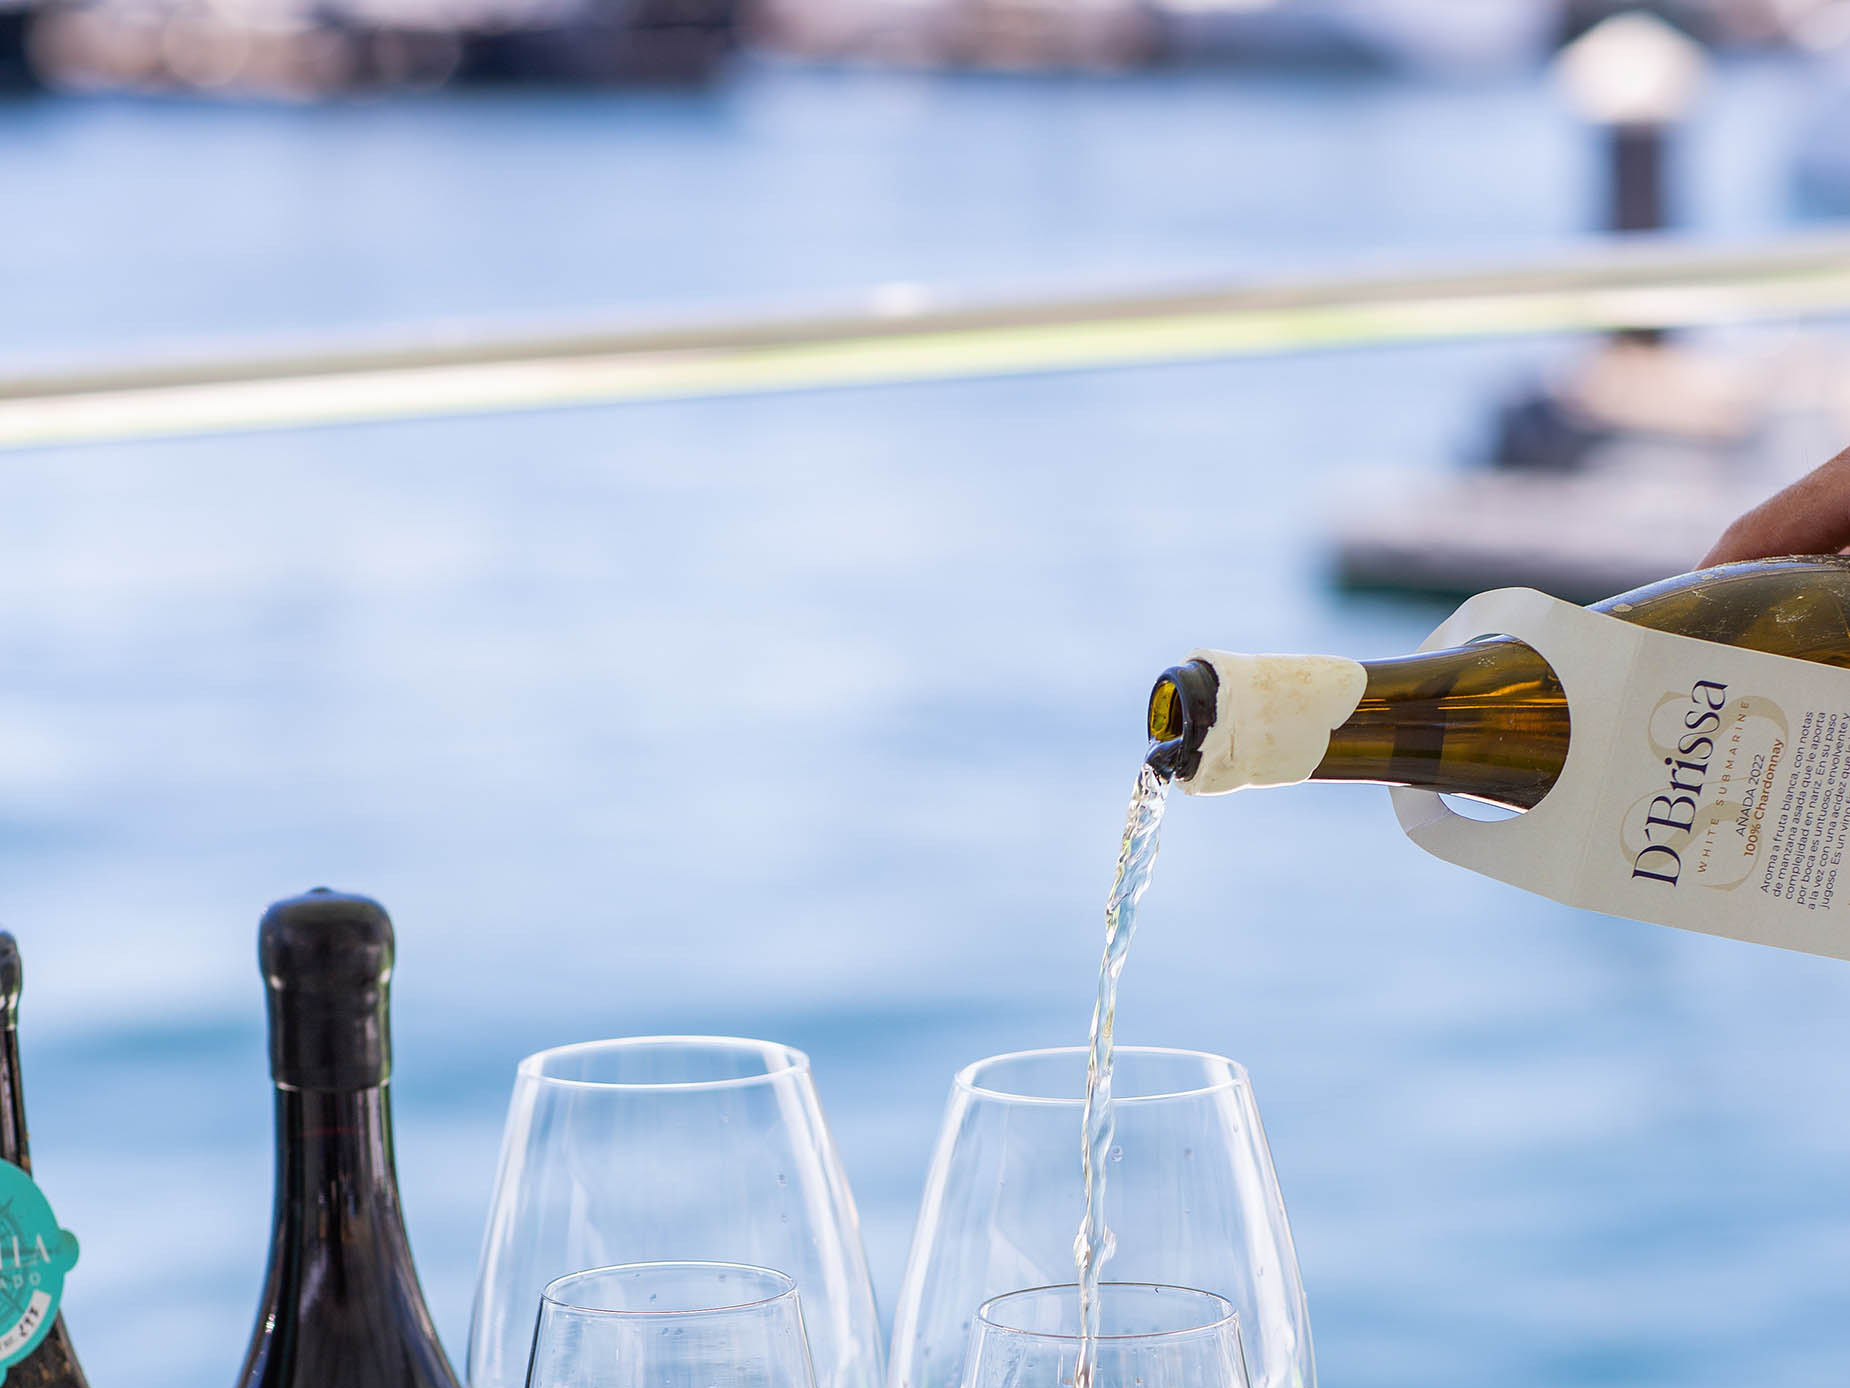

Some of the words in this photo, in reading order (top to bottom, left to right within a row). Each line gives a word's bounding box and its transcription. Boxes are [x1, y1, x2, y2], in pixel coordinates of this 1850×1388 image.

[1810, 712, 1825, 750] aporta
[1825, 714, 1837, 741] paso
[1805, 752, 1816, 762] le
[1821, 744, 1830, 757] su
[1827, 722, 1848, 785] envolvente
[1801, 765, 1813, 788] que
[1814, 760, 1826, 775] En
[1698, 818, 1719, 873] WHITE
[1715, 701, 1749, 807] SUBMARINE
[1735, 786, 1757, 837] AÑADA
[1747, 753, 1765, 785] 2022
[1743, 823, 1761, 856] 100%
[1753, 738, 1784, 820] Chardonnay
[1759, 854, 1777, 893] Aroma
[1772, 814, 1788, 841] fruta
[1780, 771, 1800, 811] blanca,
[1793, 746, 1805, 768] con
[1799, 711, 1813, 743] notas
[1792, 790, 1806, 824] asada
[1813, 787, 1834, 836] untuoso,
[1804, 811, 1813, 826] en
[1777, 826, 1797, 879] manzana
[1807, 890, 1819, 900] la
[1813, 869, 1824, 887] vez
[1819, 845, 1830, 867] con
[1825, 821, 1837, 842] una
[1831, 781, 1846, 818] acidez
[1810, 839, 1819, 852] es
[1835, 834, 1846, 849] un
[1785, 828, 1809, 899] complejidad
[1800, 854, 1815, 882] boca
[1830, 851, 1841, 864] Es
[1772, 882, 1783, 897] de
[1796, 885, 1807, 904] por
